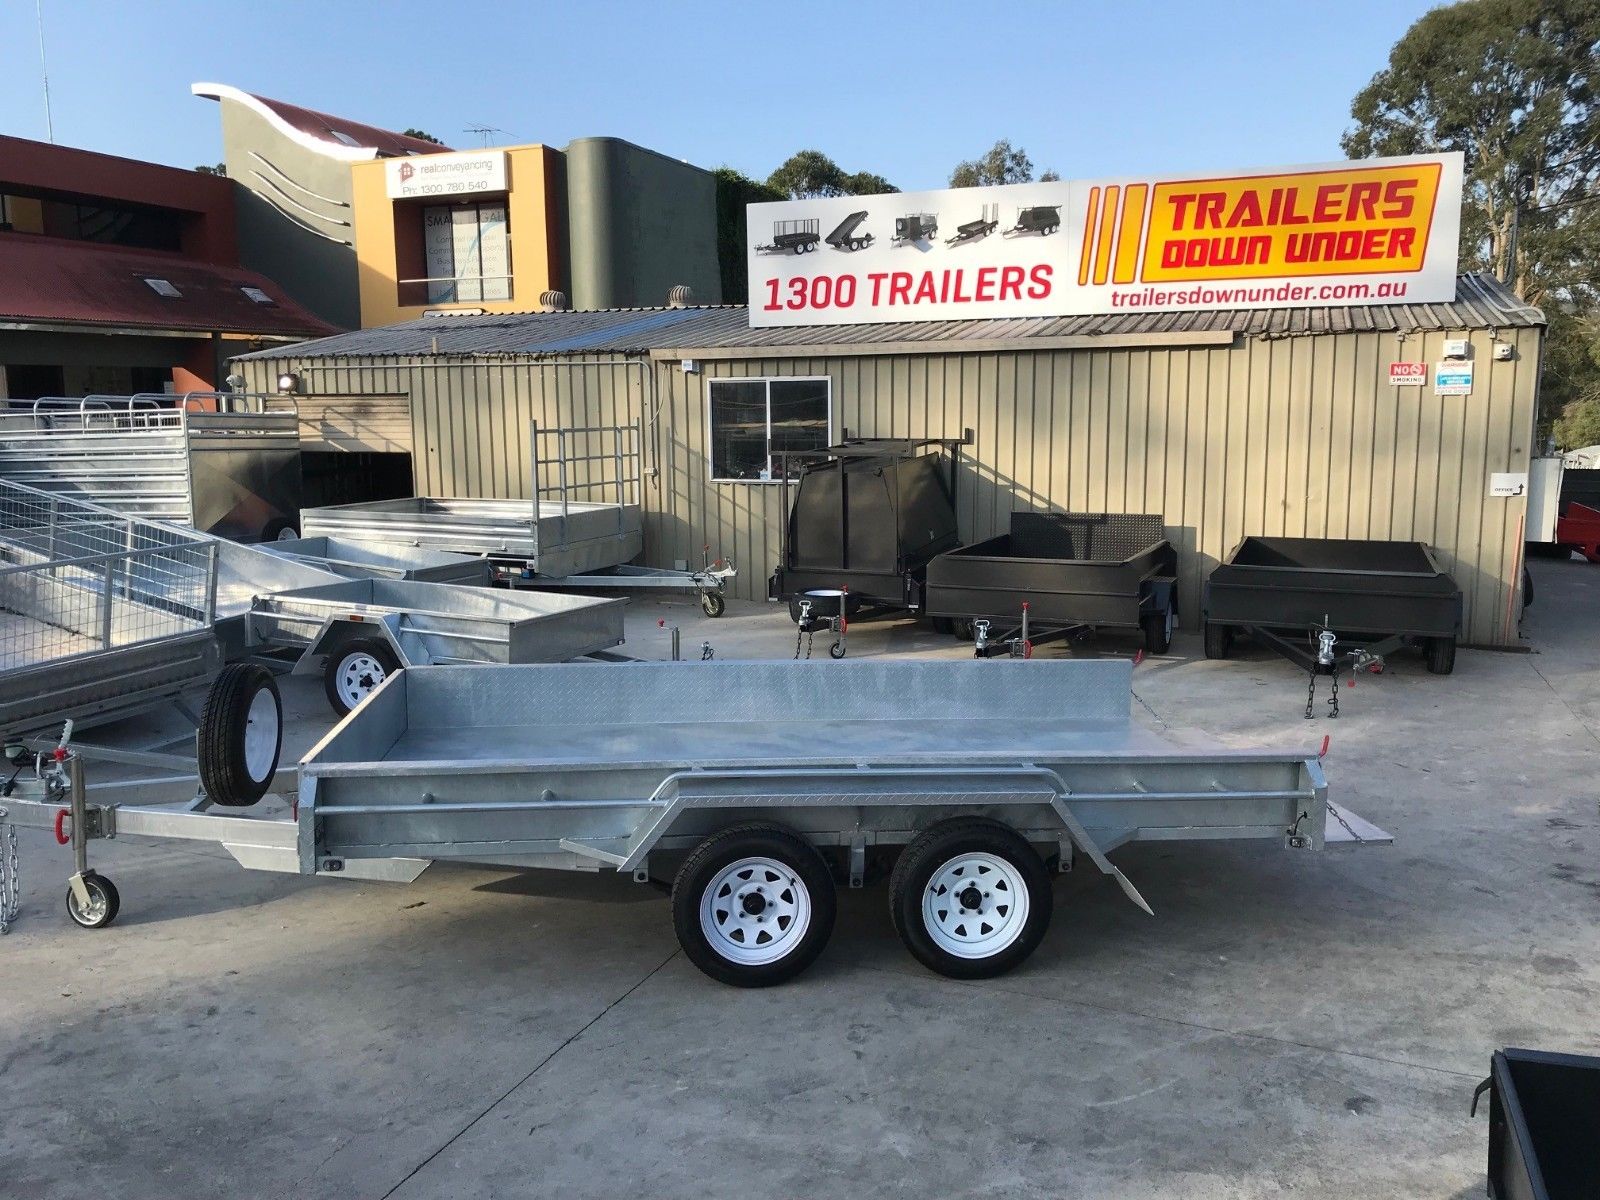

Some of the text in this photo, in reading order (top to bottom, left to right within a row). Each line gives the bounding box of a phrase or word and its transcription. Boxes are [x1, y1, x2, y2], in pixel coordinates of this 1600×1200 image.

[420, 160, 493, 174] realconveyancing
[420, 183, 443, 194] 1300
[446, 181, 465, 192] 780
[468, 179, 488, 190] 540
[1168, 179, 1419, 231] TRAILERS
[1160, 227, 1417, 269] DOWN UNDER
[763, 264, 1054, 311] 1300 TRAILERS
[1111, 281, 1408, 307] trailersdownunder.com.au
[1393, 364, 1409, 375] NO
